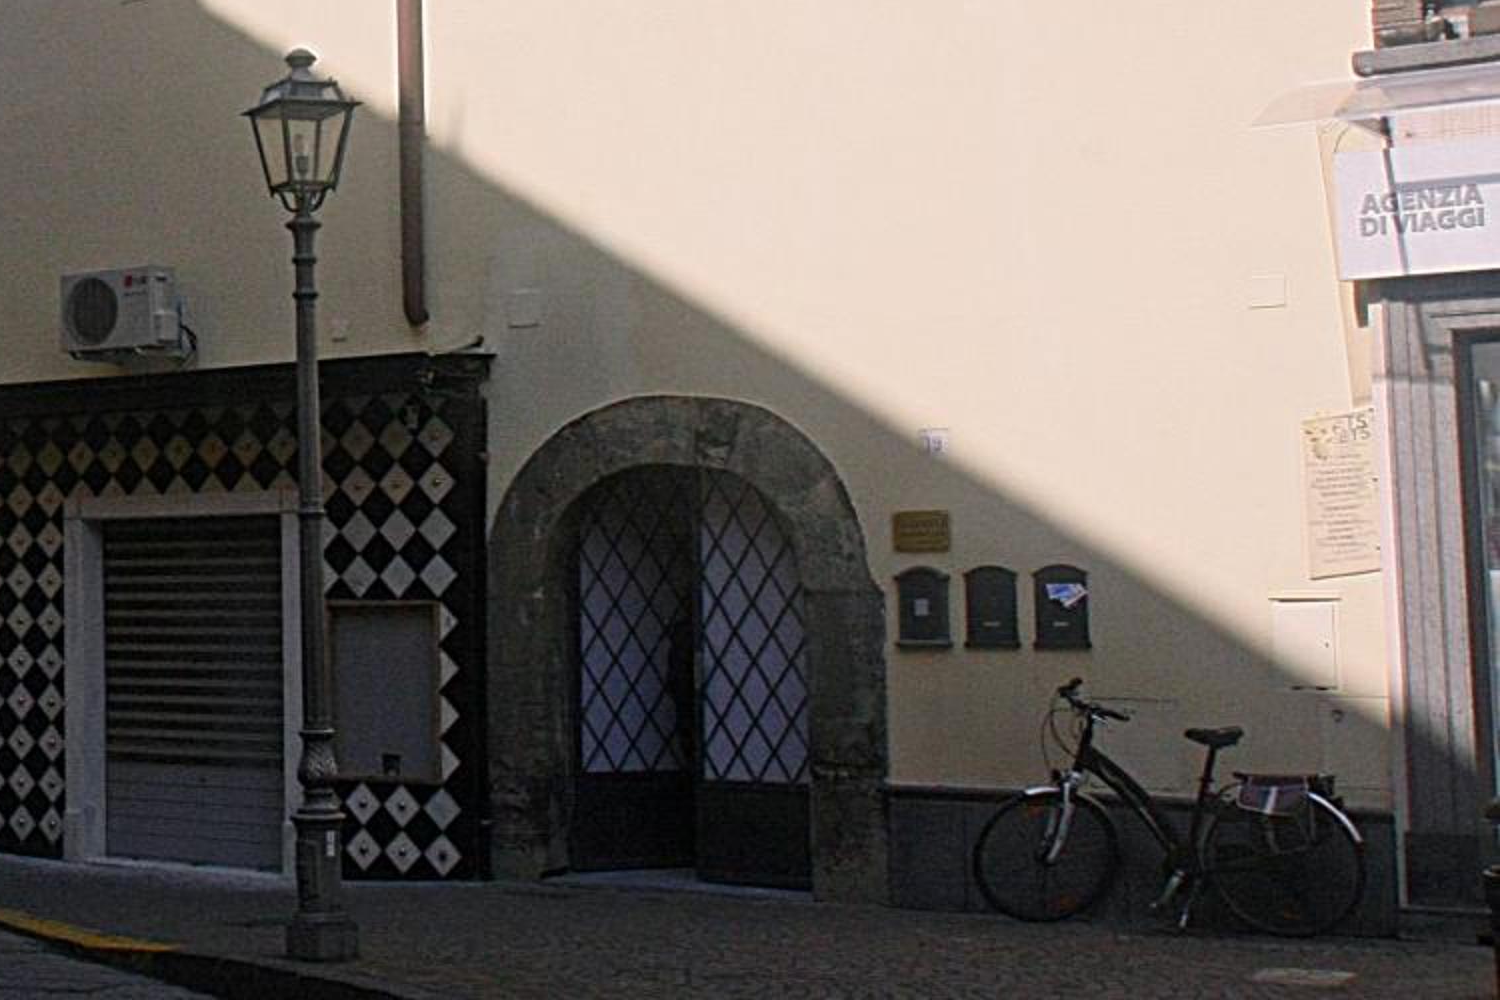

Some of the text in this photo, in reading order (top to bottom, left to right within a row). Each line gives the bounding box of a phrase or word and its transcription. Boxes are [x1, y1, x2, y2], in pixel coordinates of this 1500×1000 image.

[1361, 183, 1484, 215] AGENZIA
[1361, 207, 1485, 237] DI VIAGGI
